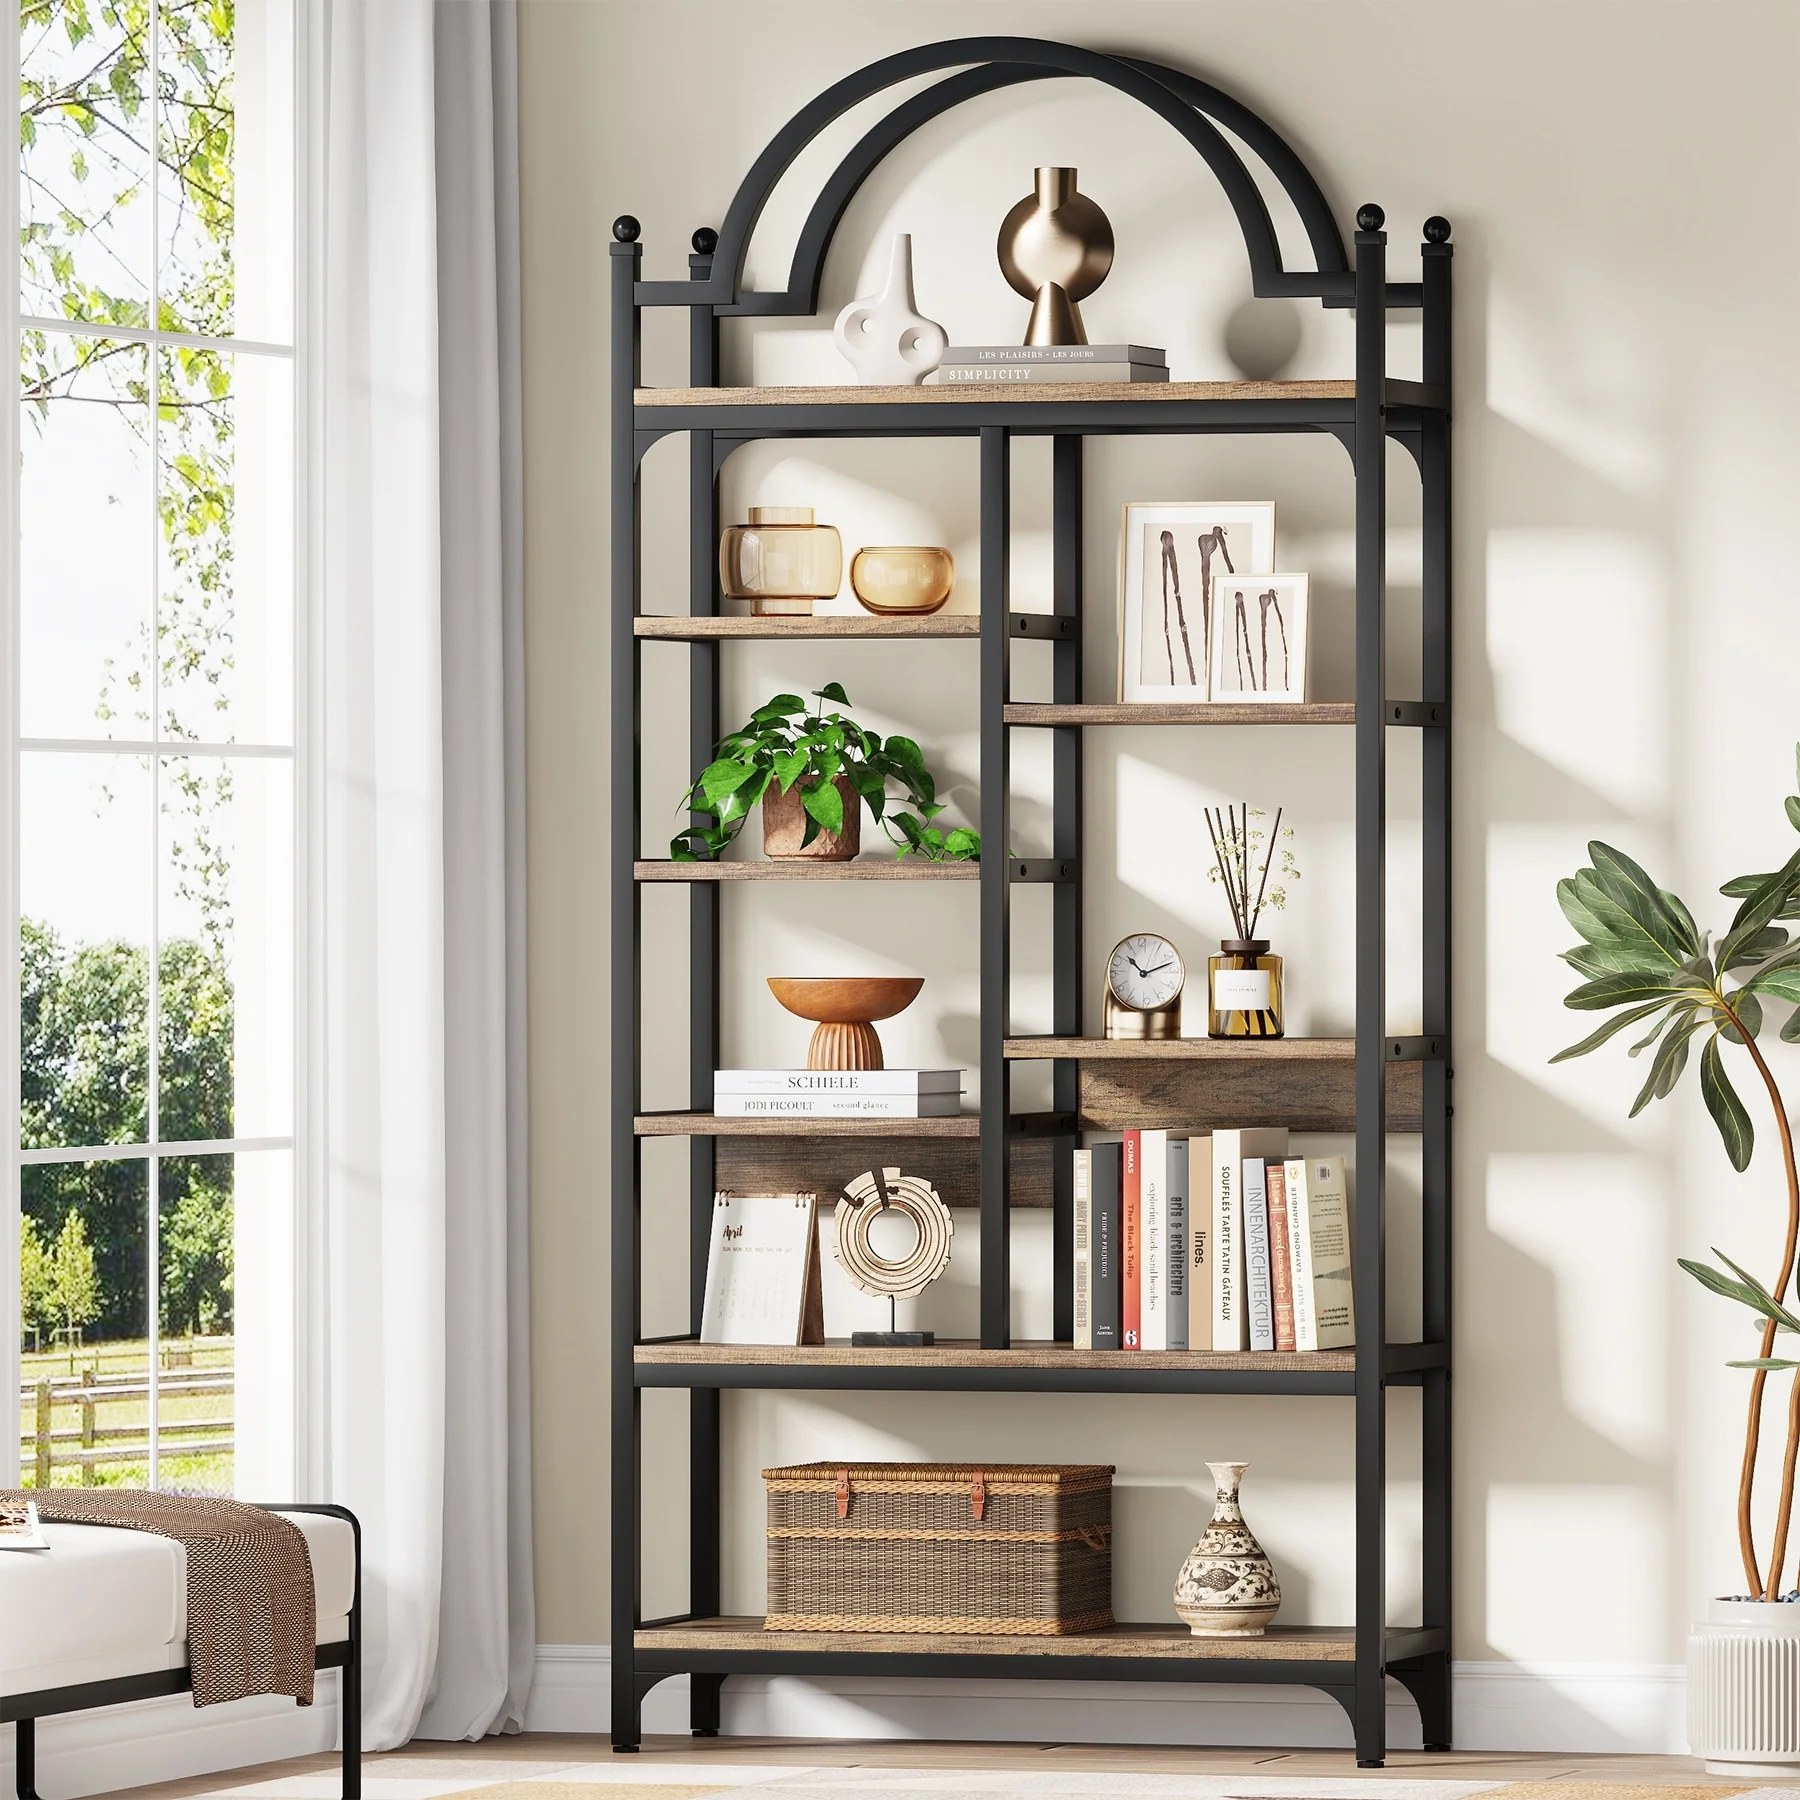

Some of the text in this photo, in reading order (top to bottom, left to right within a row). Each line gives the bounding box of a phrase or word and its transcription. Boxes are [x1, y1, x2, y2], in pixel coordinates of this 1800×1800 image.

[979, 351, 996, 359] LES
[1000, 351, 1043, 359] PLAISIRS
[1069, 350, 1094, 358] JOURS
[949, 369, 1031, 380] SIMPLICITY
[787, 1076, 859, 1089] SCHIELE
[744, 1101, 814, 1111] JODI PICOULT
[832, 1101, 889, 1111] second glance
[1076, 1201, 1087, 1223] HARRY
[1170, 1197, 1184, 1217] arts
[1291, 1187, 1299, 1229] CHANDLER
[722, 1225, 743, 1241] April
[1076, 1224, 1087, 1249] POTTER
[1221, 1215, 1231, 1243] TARTE
[1147, 1182, 1159, 1311] exploring black sand beaches
[1194, 1231, 1206, 1268] lines.
[1294, 1232, 1302, 1273] RAYMOND
[1126, 1254, 1134, 1279] Tulip
[1170, 1234, 1185, 1296] architecture
[1222, 1247, 1231, 1274] TATIN
[1248, 1187, 1269, 1338] INNENARCHITEKTUR
[1076, 1299, 1087, 1328] SECRETS
